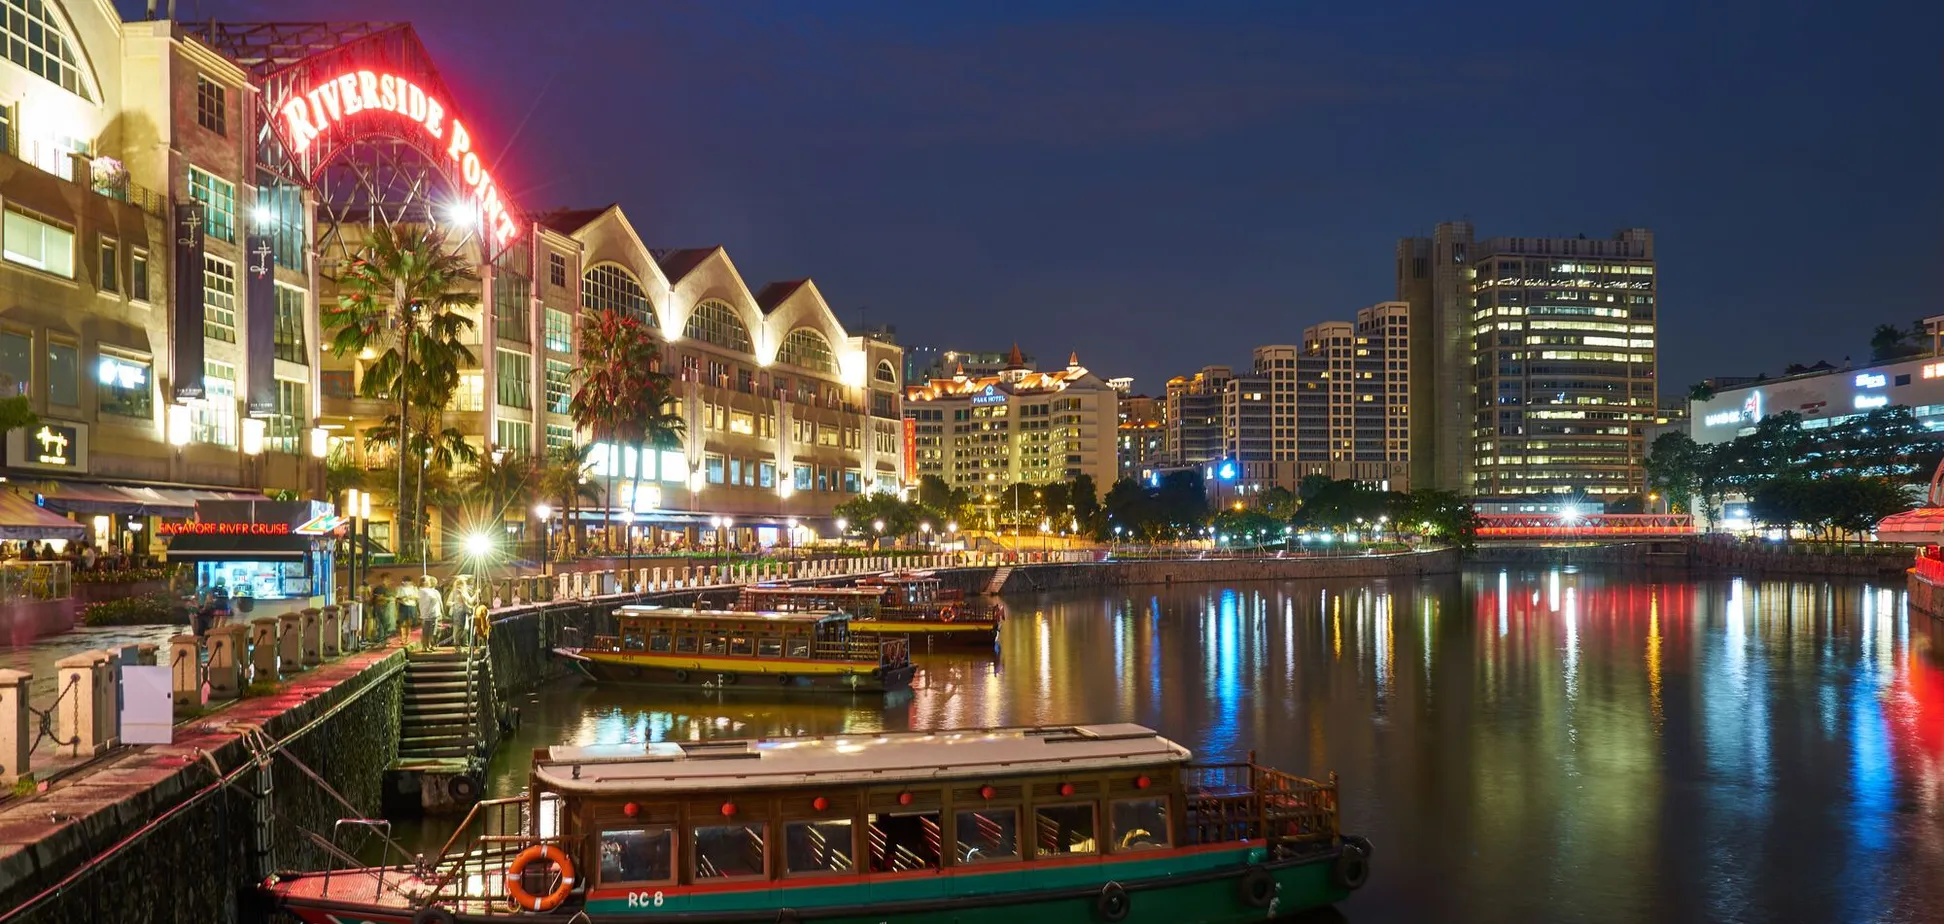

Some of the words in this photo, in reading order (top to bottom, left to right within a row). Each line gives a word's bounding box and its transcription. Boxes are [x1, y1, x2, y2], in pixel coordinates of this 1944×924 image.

[281, 70, 445, 154] RIVERSIDE
[448, 119, 516, 245] POINT
[159, 522, 217, 535] SINGAPORE
[219, 522, 249, 535] RIVER
[251, 522, 288, 535] CRUISE
[628, 891, 649, 908] RC
[654, 890, 664, 907] 8
